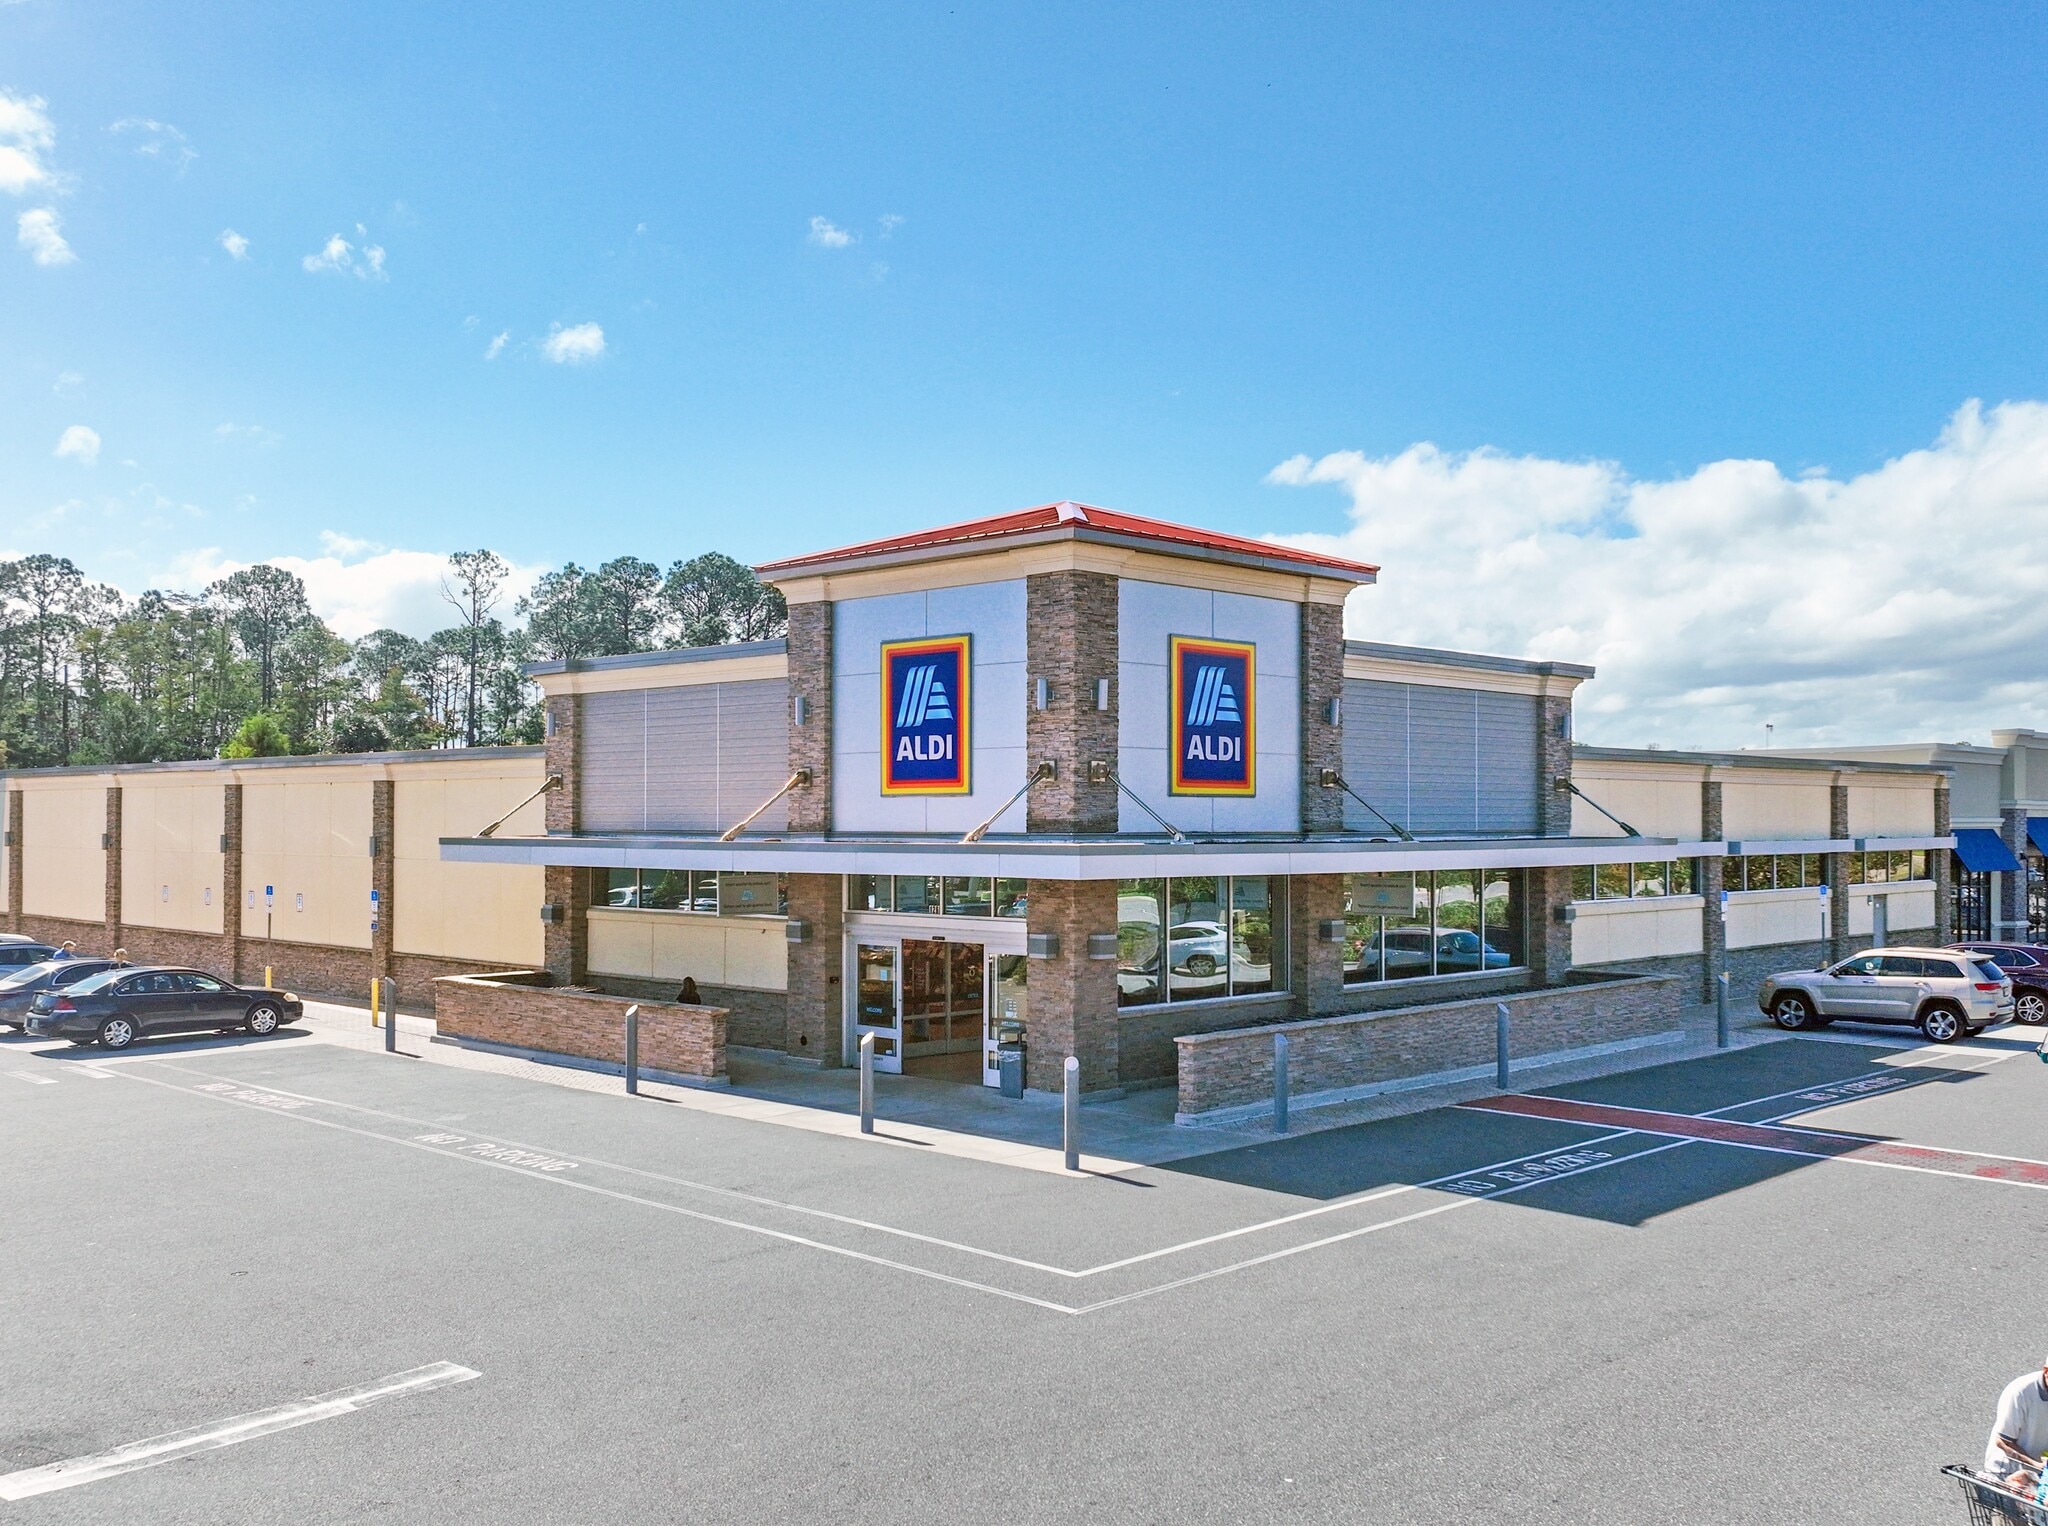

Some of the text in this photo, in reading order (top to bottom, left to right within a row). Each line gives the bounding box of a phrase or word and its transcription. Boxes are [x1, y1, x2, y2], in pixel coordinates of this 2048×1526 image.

[896, 734, 953, 762] ALDI
[1187, 734, 1241, 762] ALDI
[413, 1132, 579, 1172] NO PARKING
